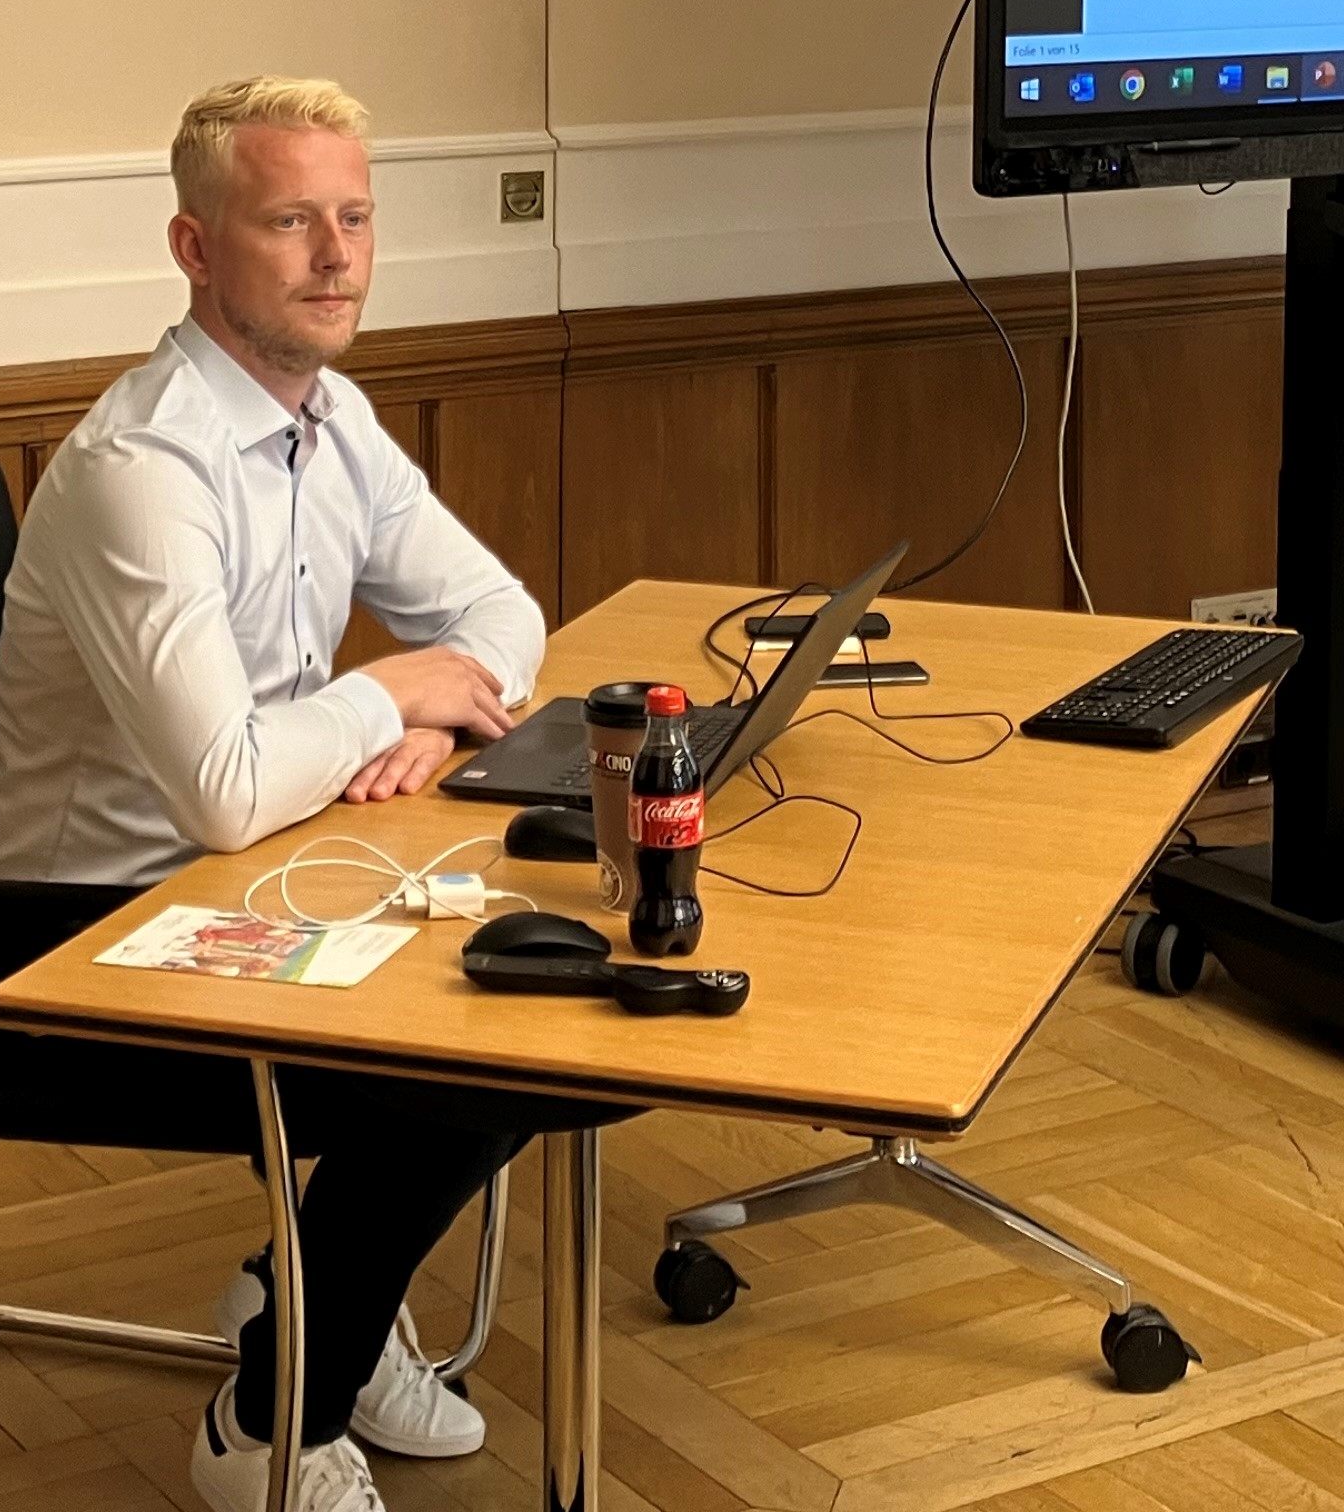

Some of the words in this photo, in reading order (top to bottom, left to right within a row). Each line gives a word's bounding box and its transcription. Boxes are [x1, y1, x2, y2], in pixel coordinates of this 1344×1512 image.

[1013, 45, 1037, 58] Folie
[1047, 46, 1066, 56] von
[1069, 43, 1081, 56] 15
